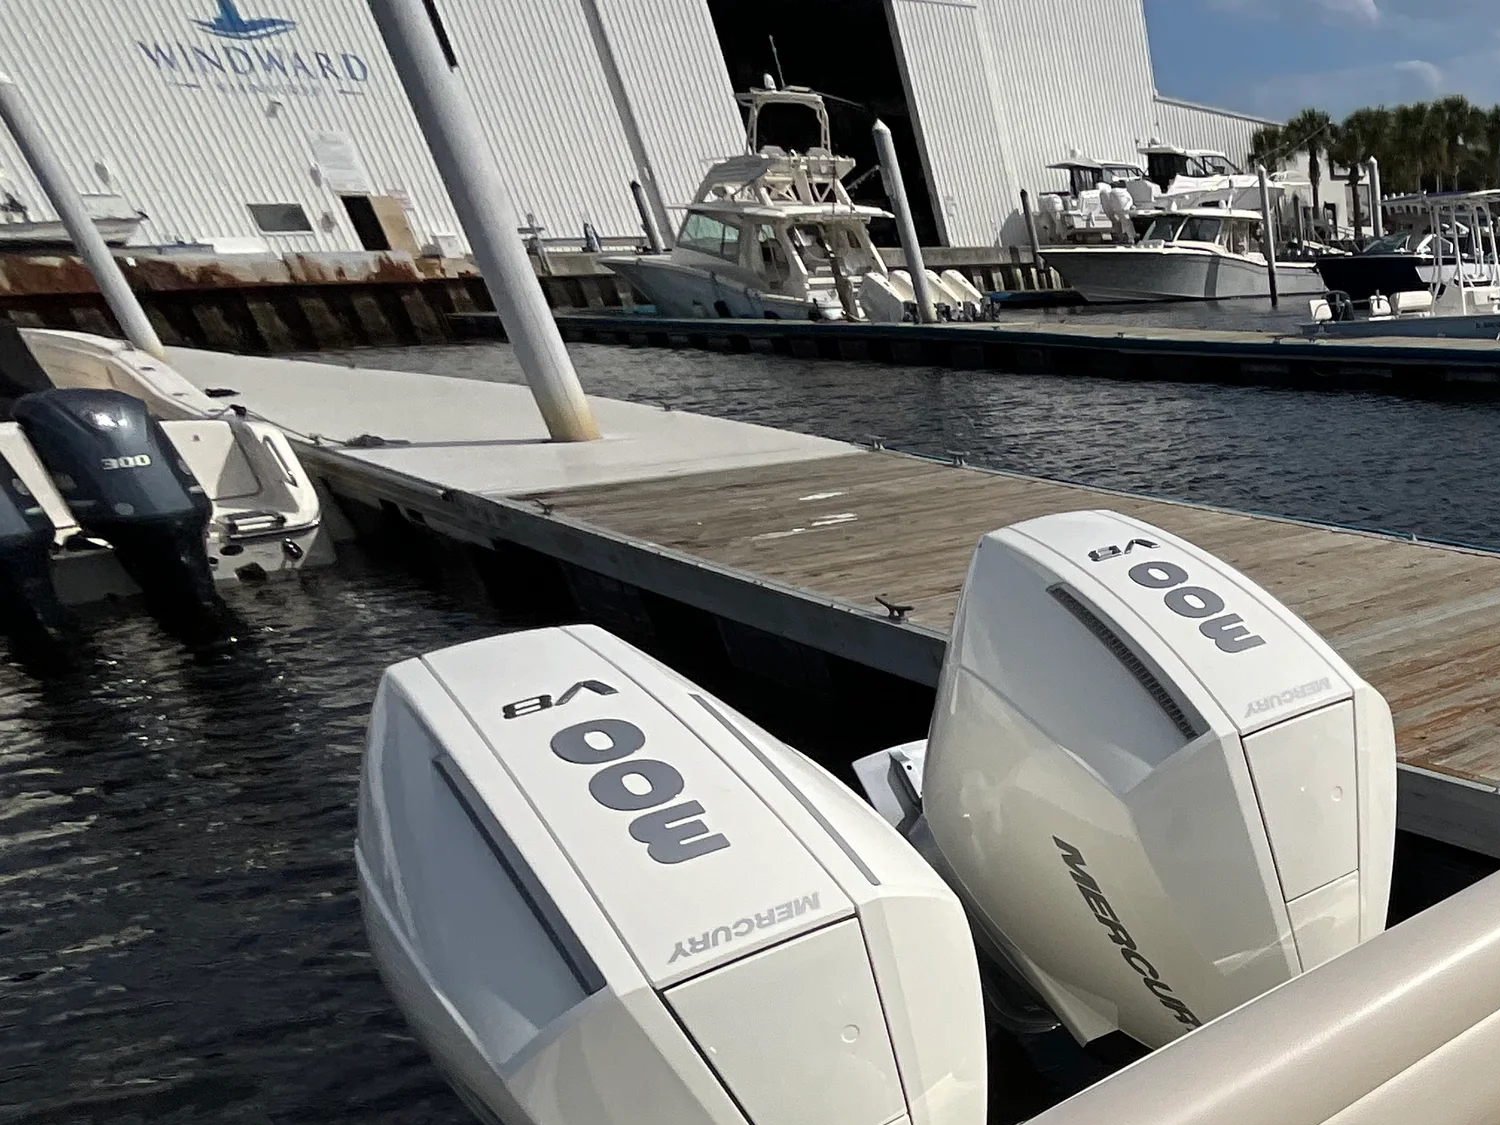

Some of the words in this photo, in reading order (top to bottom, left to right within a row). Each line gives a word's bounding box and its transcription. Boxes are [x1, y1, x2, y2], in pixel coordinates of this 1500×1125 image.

[137, 40, 368, 82] WINDWARD
[101, 454, 152, 470] 300
[1088, 539, 1161, 562] V8
[1128, 561, 1267, 654] 300
[502, 680, 619, 719] V8
[1245, 677, 1332, 717] MERCURY
[550, 718, 731, 864] 300
[666, 891, 821, 964] MERCURY
[1052, 835, 1203, 1031] MERCUR
